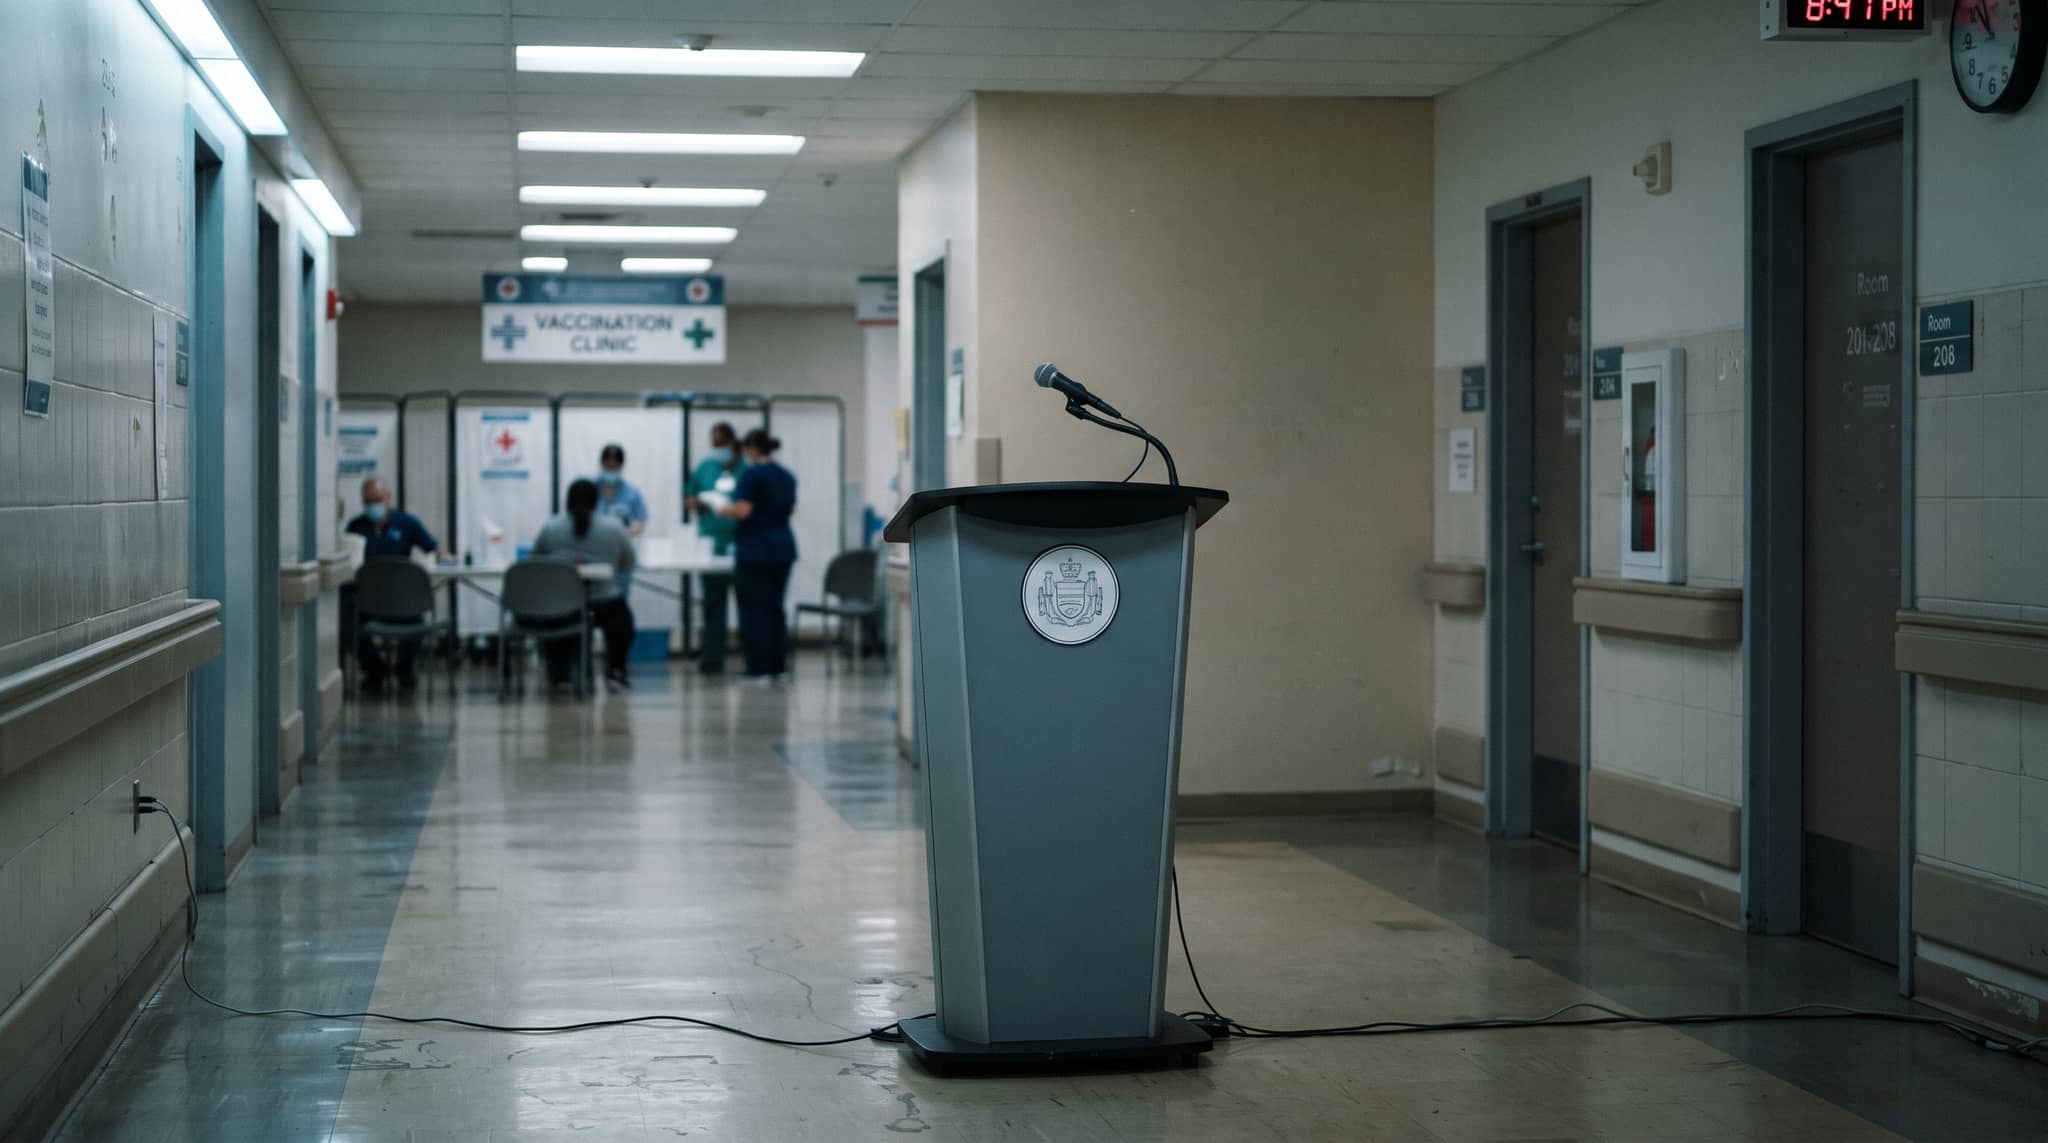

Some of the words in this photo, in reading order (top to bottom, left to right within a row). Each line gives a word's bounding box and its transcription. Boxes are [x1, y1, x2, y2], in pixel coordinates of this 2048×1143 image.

[1882, 0, 1914, 20] PM
[1964, 32, 1972, 50] 9
[1968, 58, 1976, 76] 8
[2001, 65, 2009, 84] 5
[1976, 72, 1984, 91] 7
[1988, 77, 1996, 95] 6
[1857, 271, 1889, 296] Room
[534, 313, 673, 332] VACCINATION
[1927, 314, 1951, 332] Room
[570, 335, 637, 353] CLINIC
[1933, 344, 1956, 368] 208
